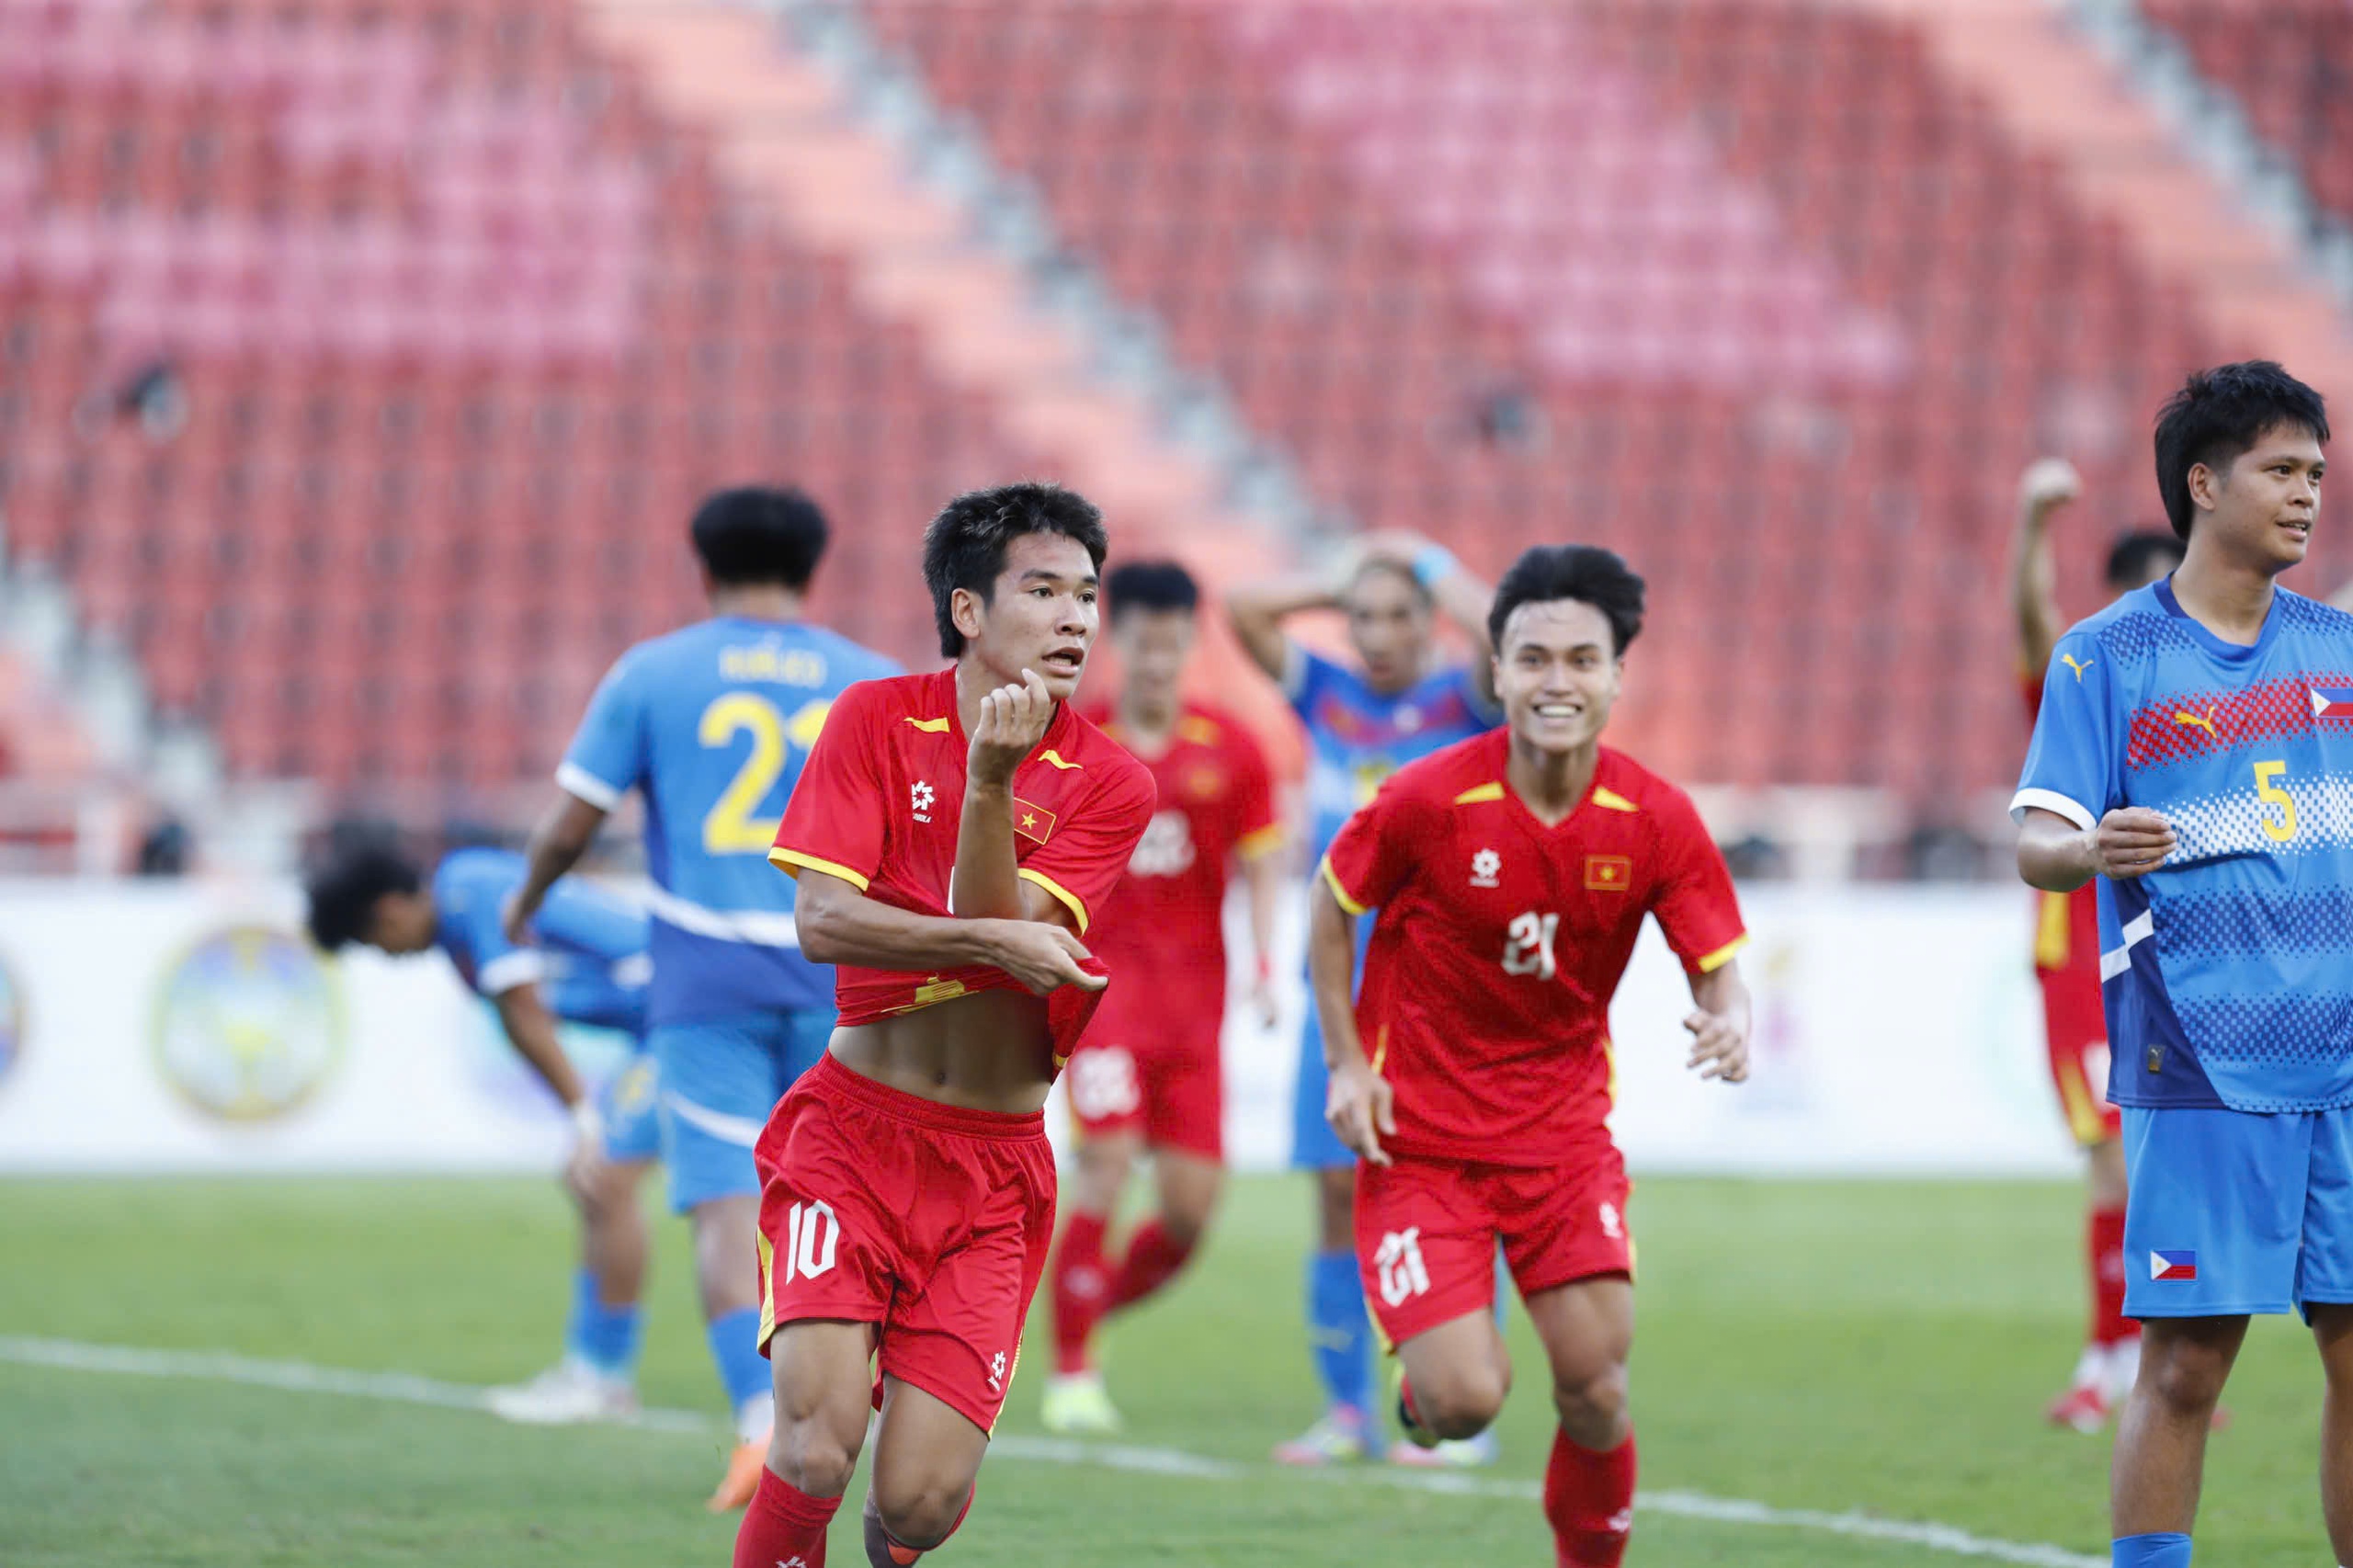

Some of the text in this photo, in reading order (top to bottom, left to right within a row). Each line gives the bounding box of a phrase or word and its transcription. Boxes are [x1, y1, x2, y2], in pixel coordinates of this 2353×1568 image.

[2254, 759, 2298, 843] 5
[1500, 910, 1560, 981] 21
[785, 1199, 840, 1286] 10
[1373, 1225, 1431, 1308] 21
